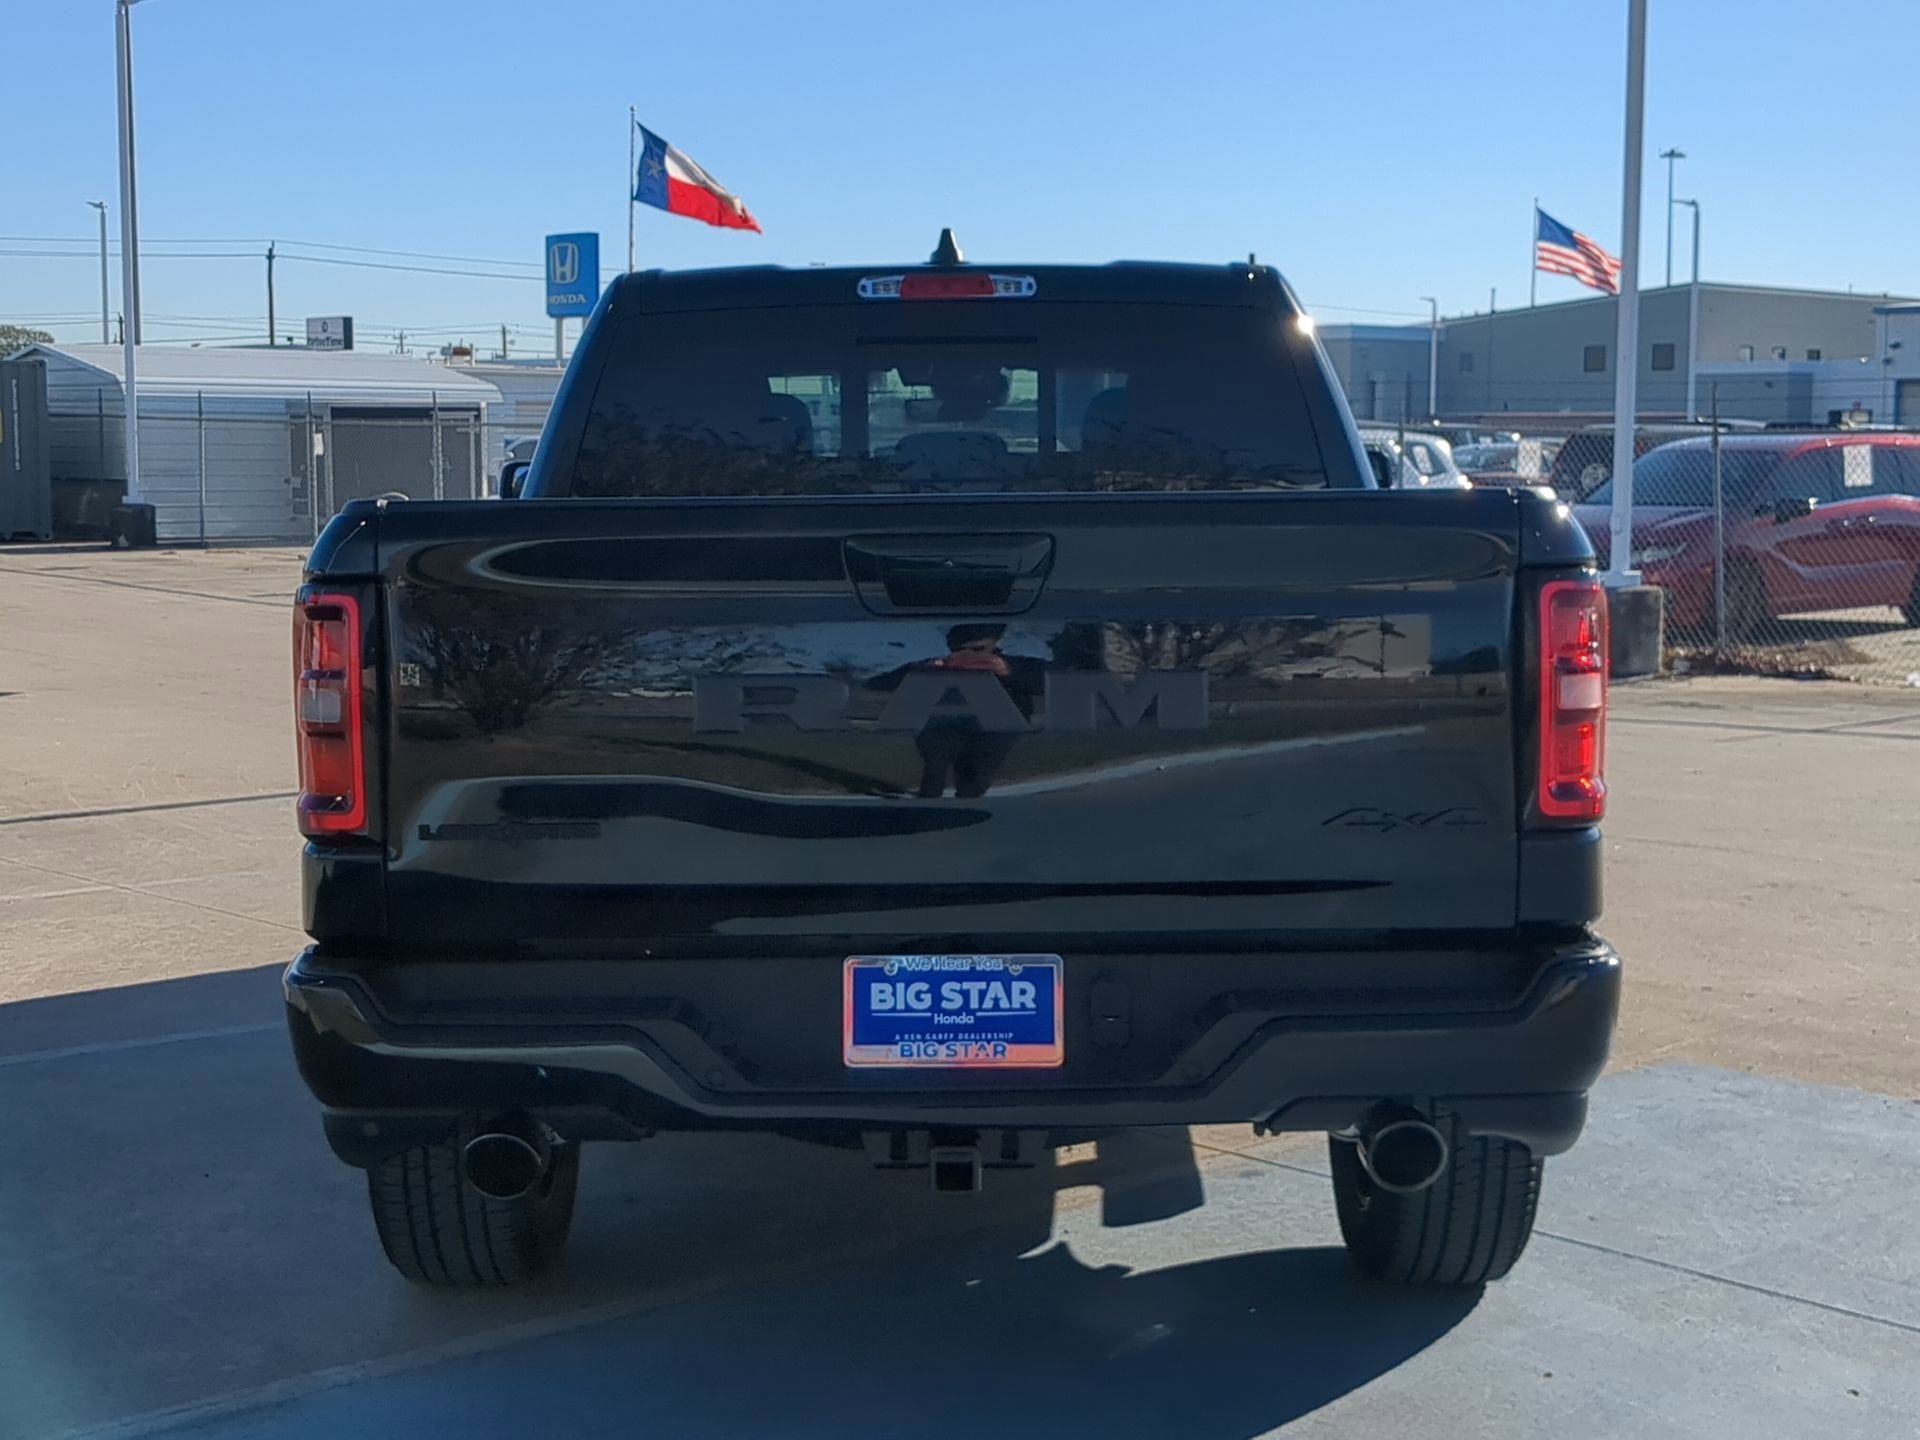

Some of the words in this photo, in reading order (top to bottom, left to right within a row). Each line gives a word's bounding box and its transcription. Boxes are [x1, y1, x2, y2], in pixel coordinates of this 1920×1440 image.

[694, 671, 1209, 733] RAM
[905, 956, 931, 971] We
[934, 956, 972, 971] Hear
[973, 956, 1003, 971] You
[870, 982, 932, 1010] BIG
[940, 981, 1037, 1009] STAR
[933, 1012, 975, 1025] Honda
[895, 1033, 901, 1041] A
[958, 1032, 1014, 1040] DEALERSHIP
[899, 1042, 939, 1058] BIG
[944, 1042, 1008, 1058] STAR
